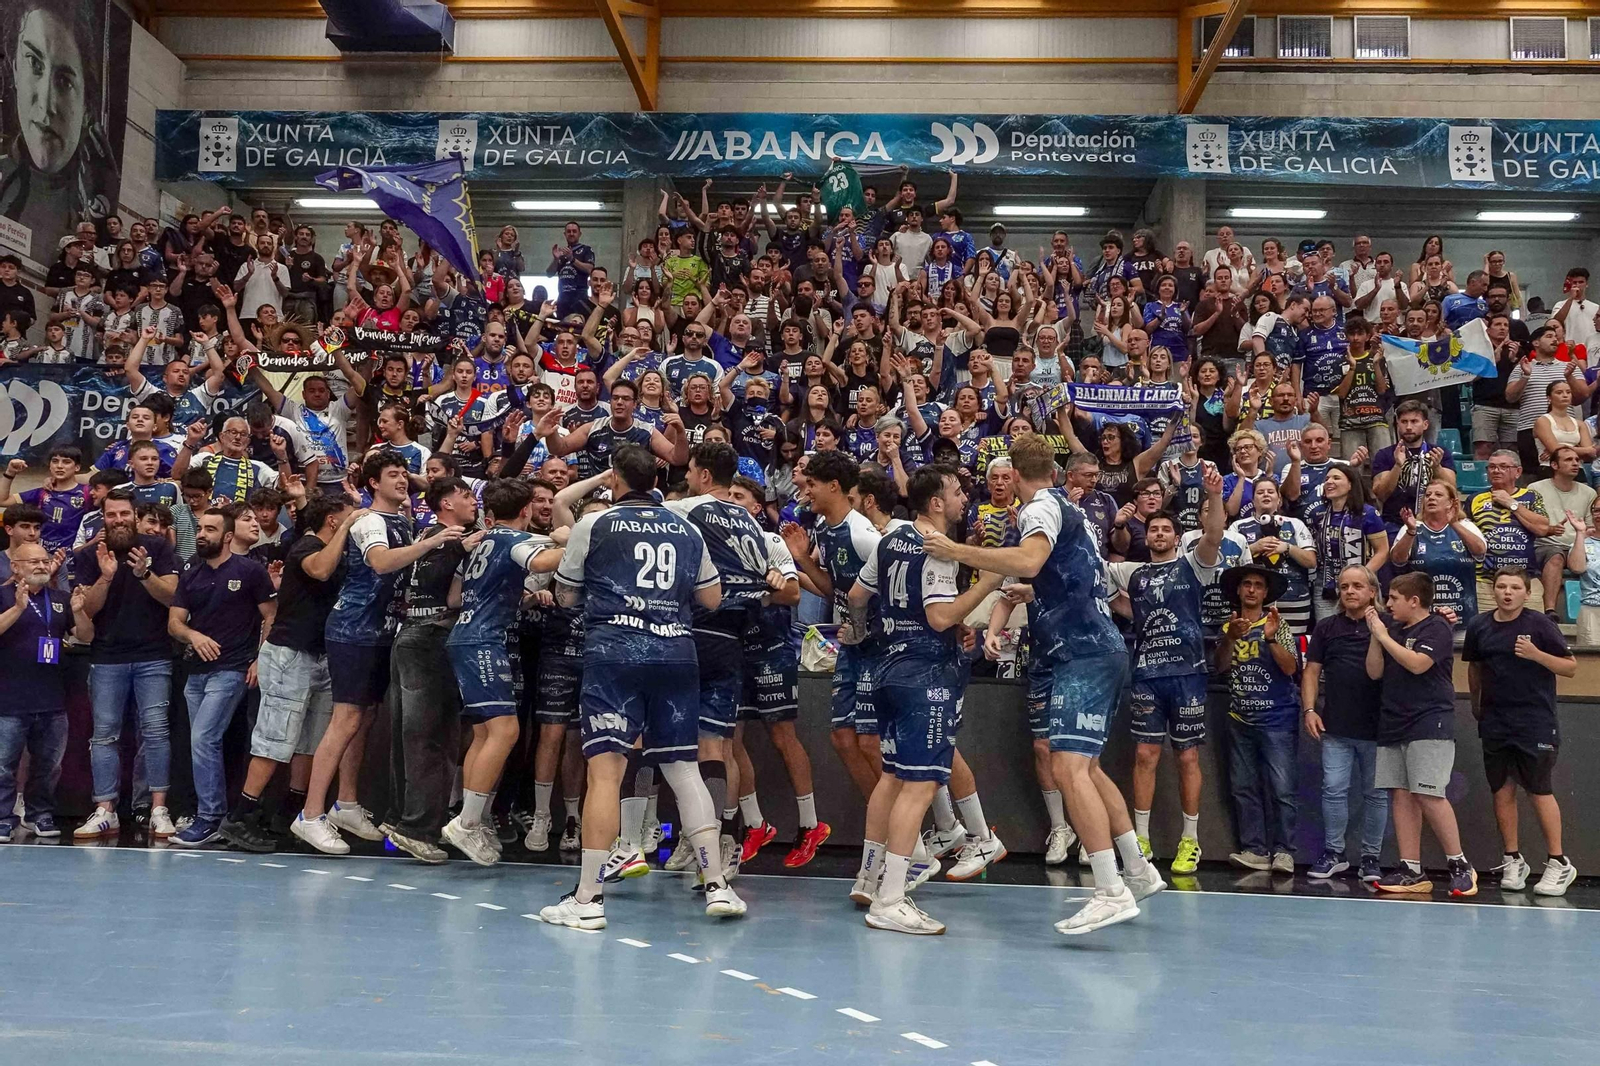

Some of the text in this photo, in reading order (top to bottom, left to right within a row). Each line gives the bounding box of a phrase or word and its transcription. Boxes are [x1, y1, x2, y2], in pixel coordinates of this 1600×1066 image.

[247, 123, 335, 143] XUNTA
[488, 125, 576, 146] XUNTA
[1011, 131, 1136, 151] Deputación
[1240, 130, 1336, 152] XUNTA
[1503, 132, 1600, 154] XUNTA
[689, 131, 893, 161] ABANCA
[246, 147, 388, 167] DE GALICIA
[484, 148, 630, 167] DE GALICIA
[1011, 151, 1136, 164] Pontevedra
[1240, 156, 1399, 176] DE GALICIA
[1503, 159, 1539, 178] DE
[829, 172, 849, 192] 23
[258, 352, 309, 367] Benvidos
[1356, 373, 1366, 385] 51
[1075, 387, 1140, 401] BALONMÁN
[1268, 429, 1301, 444] MALIBU
[1185, 487, 1199, 503] 19
[53, 507, 63, 523] 14
[617, 521, 688, 536] ABANCA
[725, 534, 767, 576] 10
[1488, 543, 1526, 551] MORRAZO
[634, 542, 676, 590] 29
[887, 560, 910, 608] 14
[608, 615, 644, 629] JAVI
[1147, 651, 1169, 659] XUNTA
[1239, 640, 1259, 658] 24
[927, 705, 936, 749] de Cangas
[935, 706, 944, 744] Concello
[1418, 782, 1437, 790] Kempa
[699, 847, 709, 869] Kempa
[864, 849, 875, 872] Kempa
[595, 863, 606, 884] Kempa
